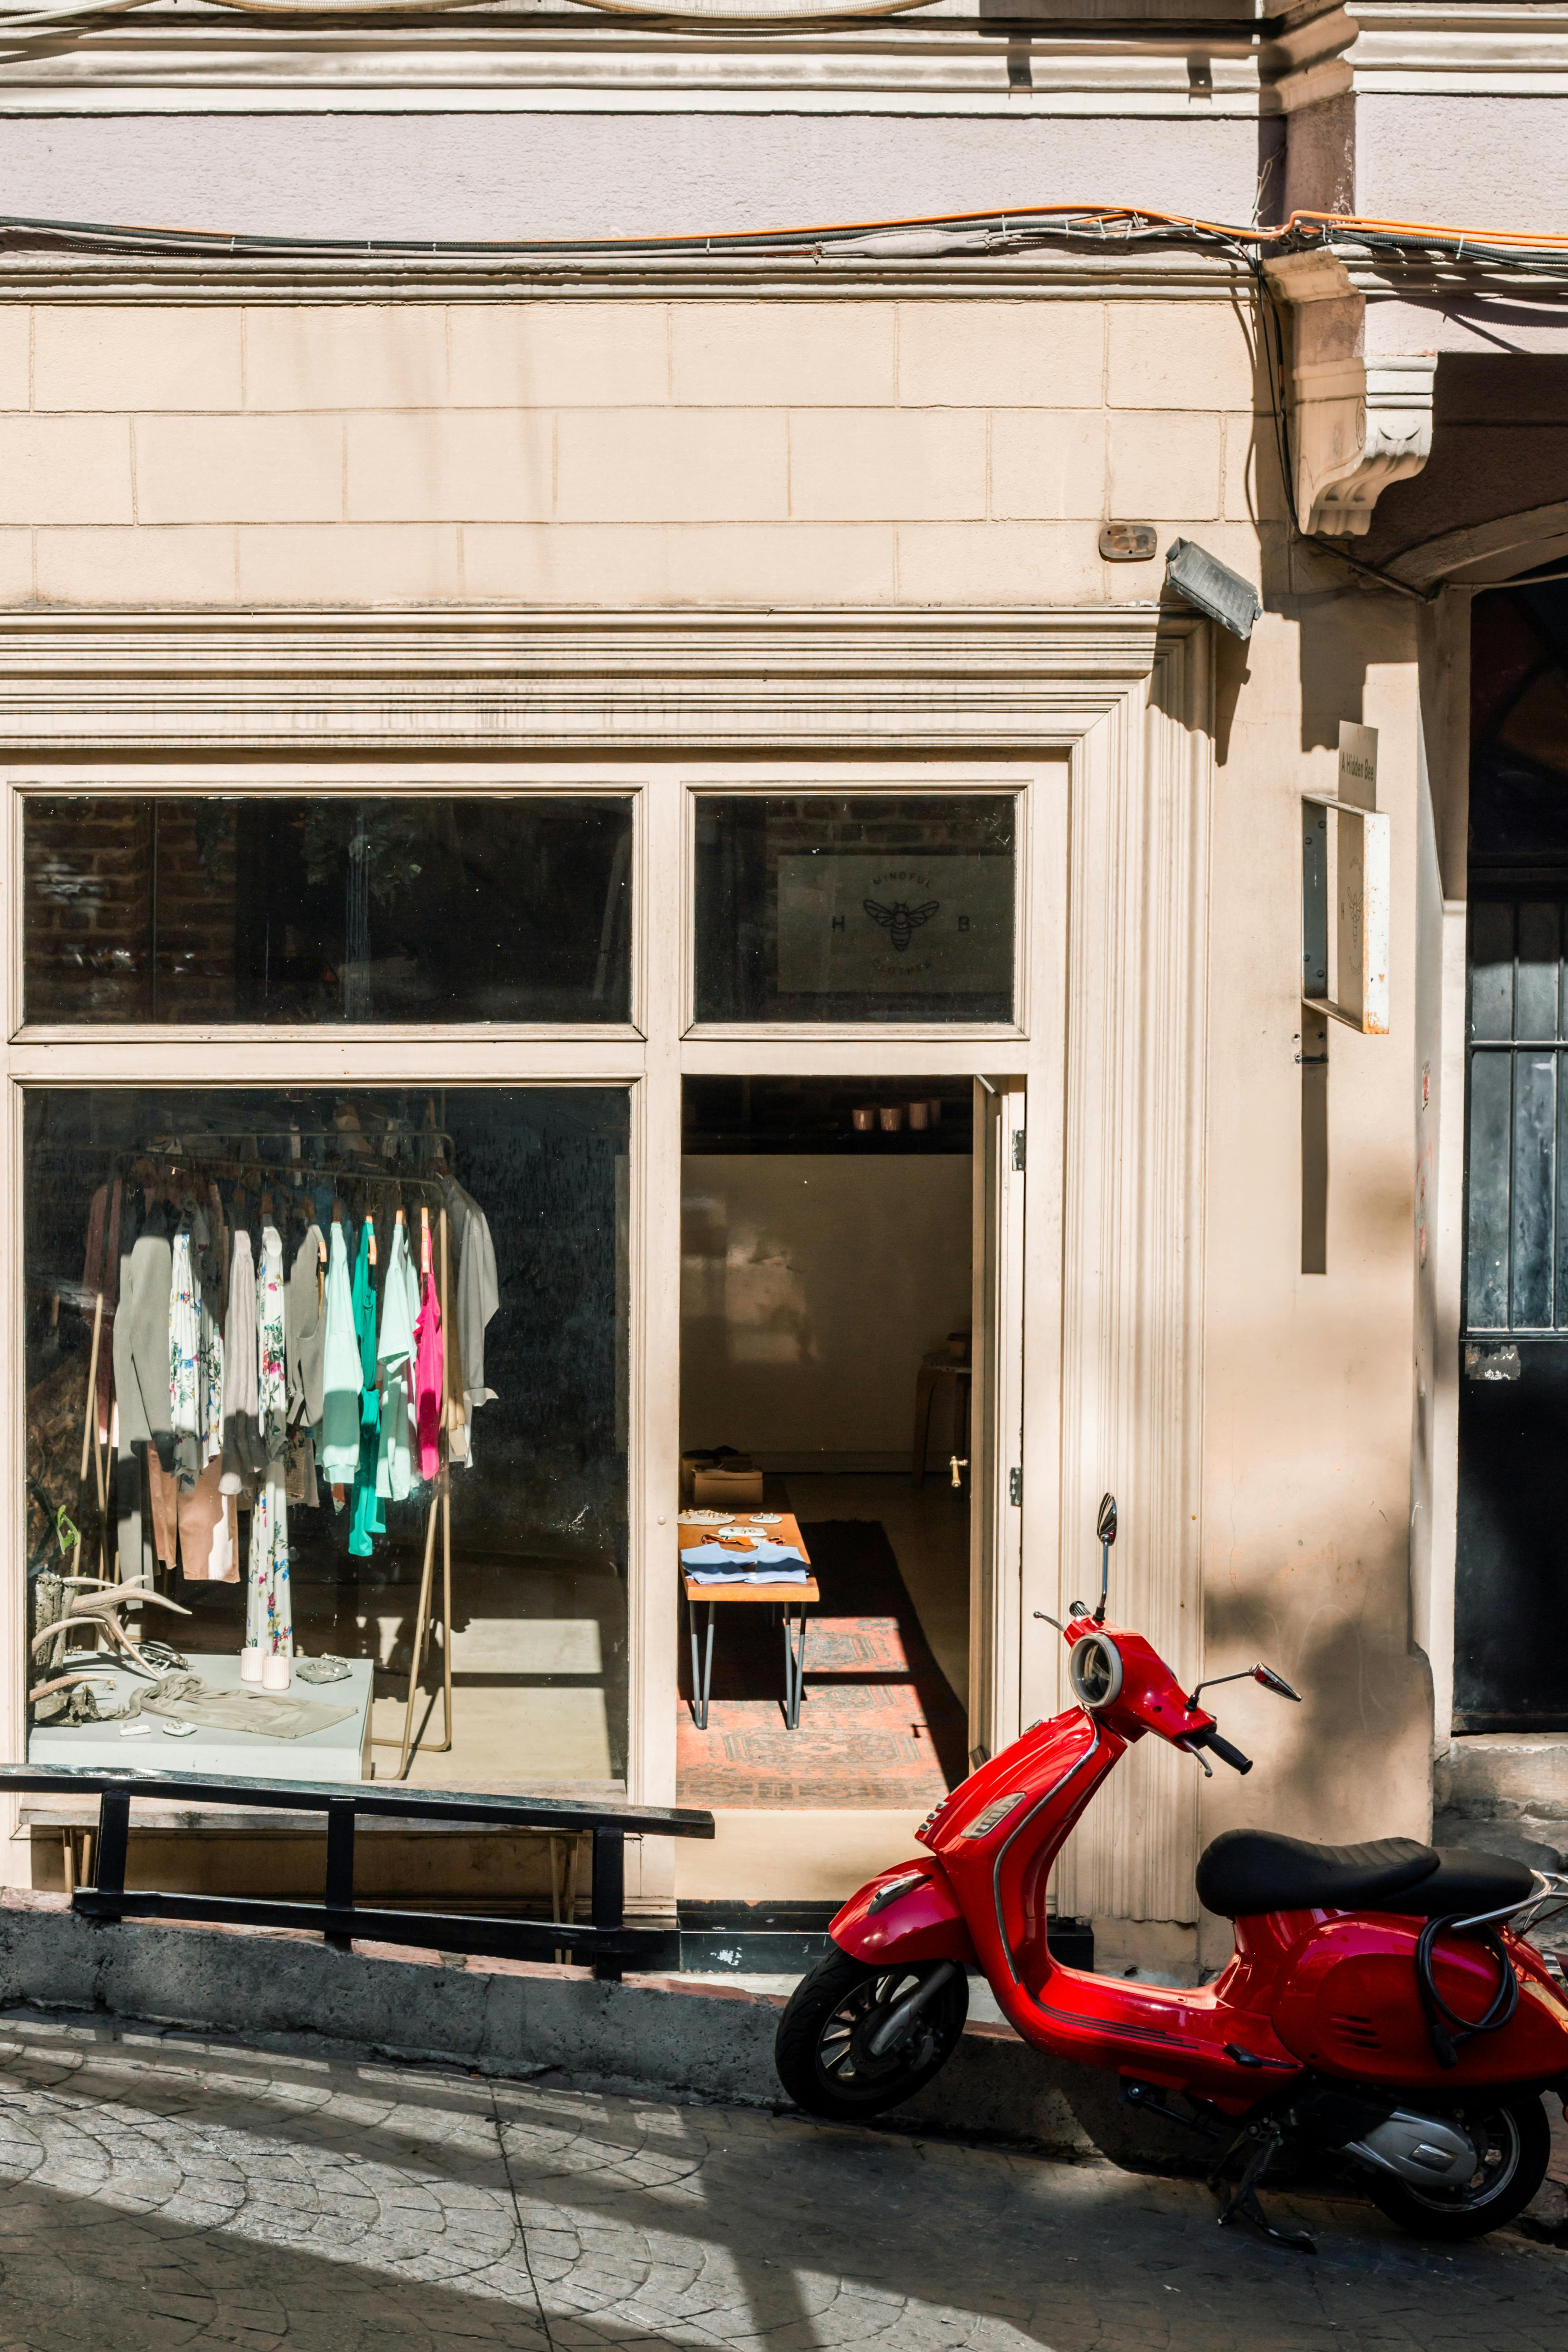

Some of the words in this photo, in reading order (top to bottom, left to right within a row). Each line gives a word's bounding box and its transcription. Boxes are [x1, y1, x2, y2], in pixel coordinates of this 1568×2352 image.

[1341, 752, 1345, 773] A
[1346, 753, 1364, 778] Hidden
[1364, 758, 1374, 782] Bee
[873, 872, 930, 889] MINDFUL
[1341, 902, 1345, 921] H
[832, 916, 845, 932] H
[958, 916, 970, 931] B
